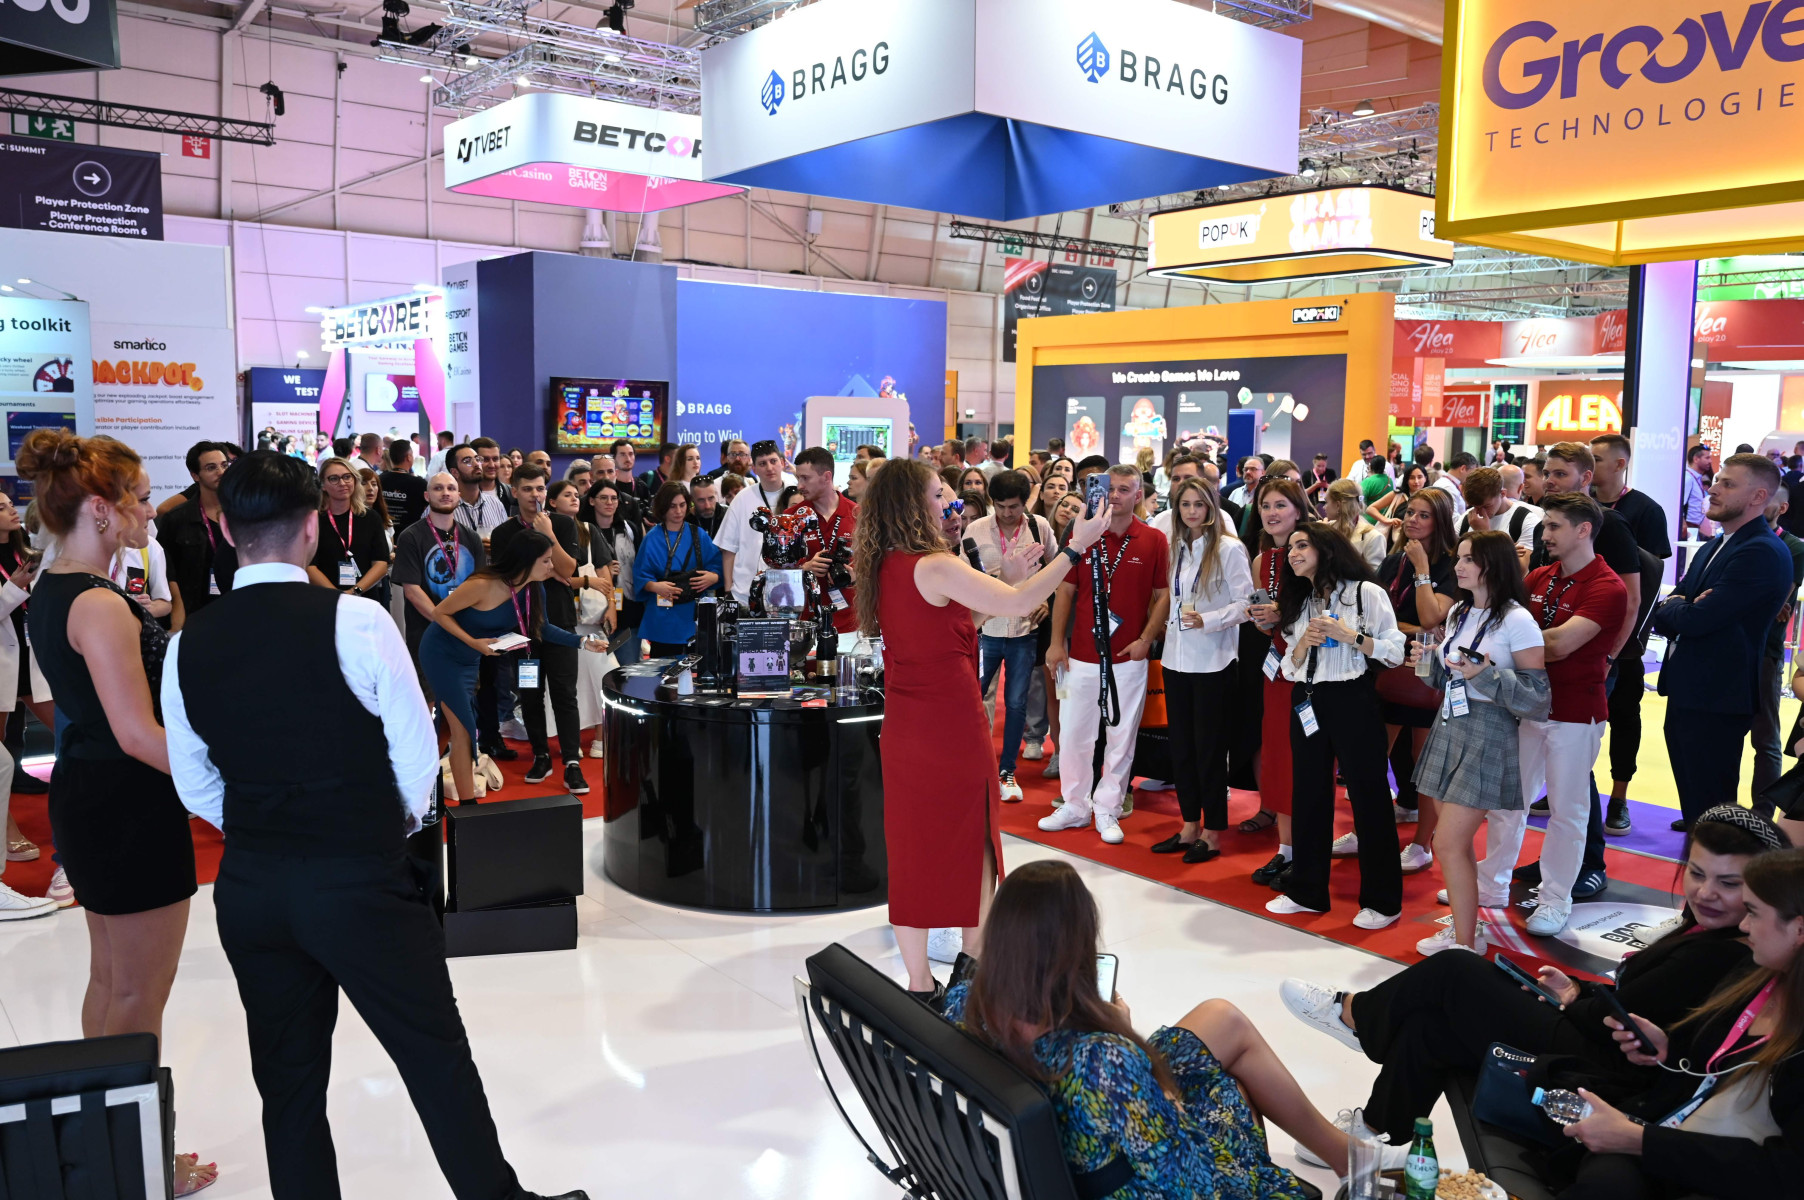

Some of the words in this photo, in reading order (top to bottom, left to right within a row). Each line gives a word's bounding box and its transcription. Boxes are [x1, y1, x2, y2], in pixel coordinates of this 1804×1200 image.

[1482, 0, 1804, 110] Groove
[792, 41, 889, 101] BRAGG
[1120, 49, 1228, 105] BRAGG
[1485, 82, 1796, 152] TECHNOLOGIE
[10, 145, 46, 155] SUMMIT
[475, 126, 512, 157] TVBET
[568, 178, 608, 192] GAMES
[35, 195, 69, 208] Player
[70, 198, 123, 212] Protection
[124, 204, 150, 214] Zone
[50, 211, 83, 223] Player
[85, 213, 137, 226] Protection
[48, 219, 109, 233] Conference
[111, 224, 139, 235] Room
[141, 227, 148, 236] 6
[11, 317, 72, 332] toolkit
[1600, 314, 1623, 348] Alea
[113, 338, 167, 351] smartico
[1407, 322, 1454, 353] Alea
[1515, 324, 1556, 354] Alea
[449, 342, 468, 353] GAMES
[283, 374, 301, 384] WE
[1127, 371, 1159, 384] Create
[1161, 370, 1195, 383] Games
[1214, 369, 1240, 381] Love
[294, 387, 319, 397] TEST
[687, 402, 732, 415] BRAGG
[1443, 397, 1475, 423] Alea
[1537, 394, 1623, 432] ALEA
[116, 417, 163, 425] Participation
[677, 429, 701, 447] ying
[704, 430, 716, 443] to
[382, 490, 407, 499] martico
